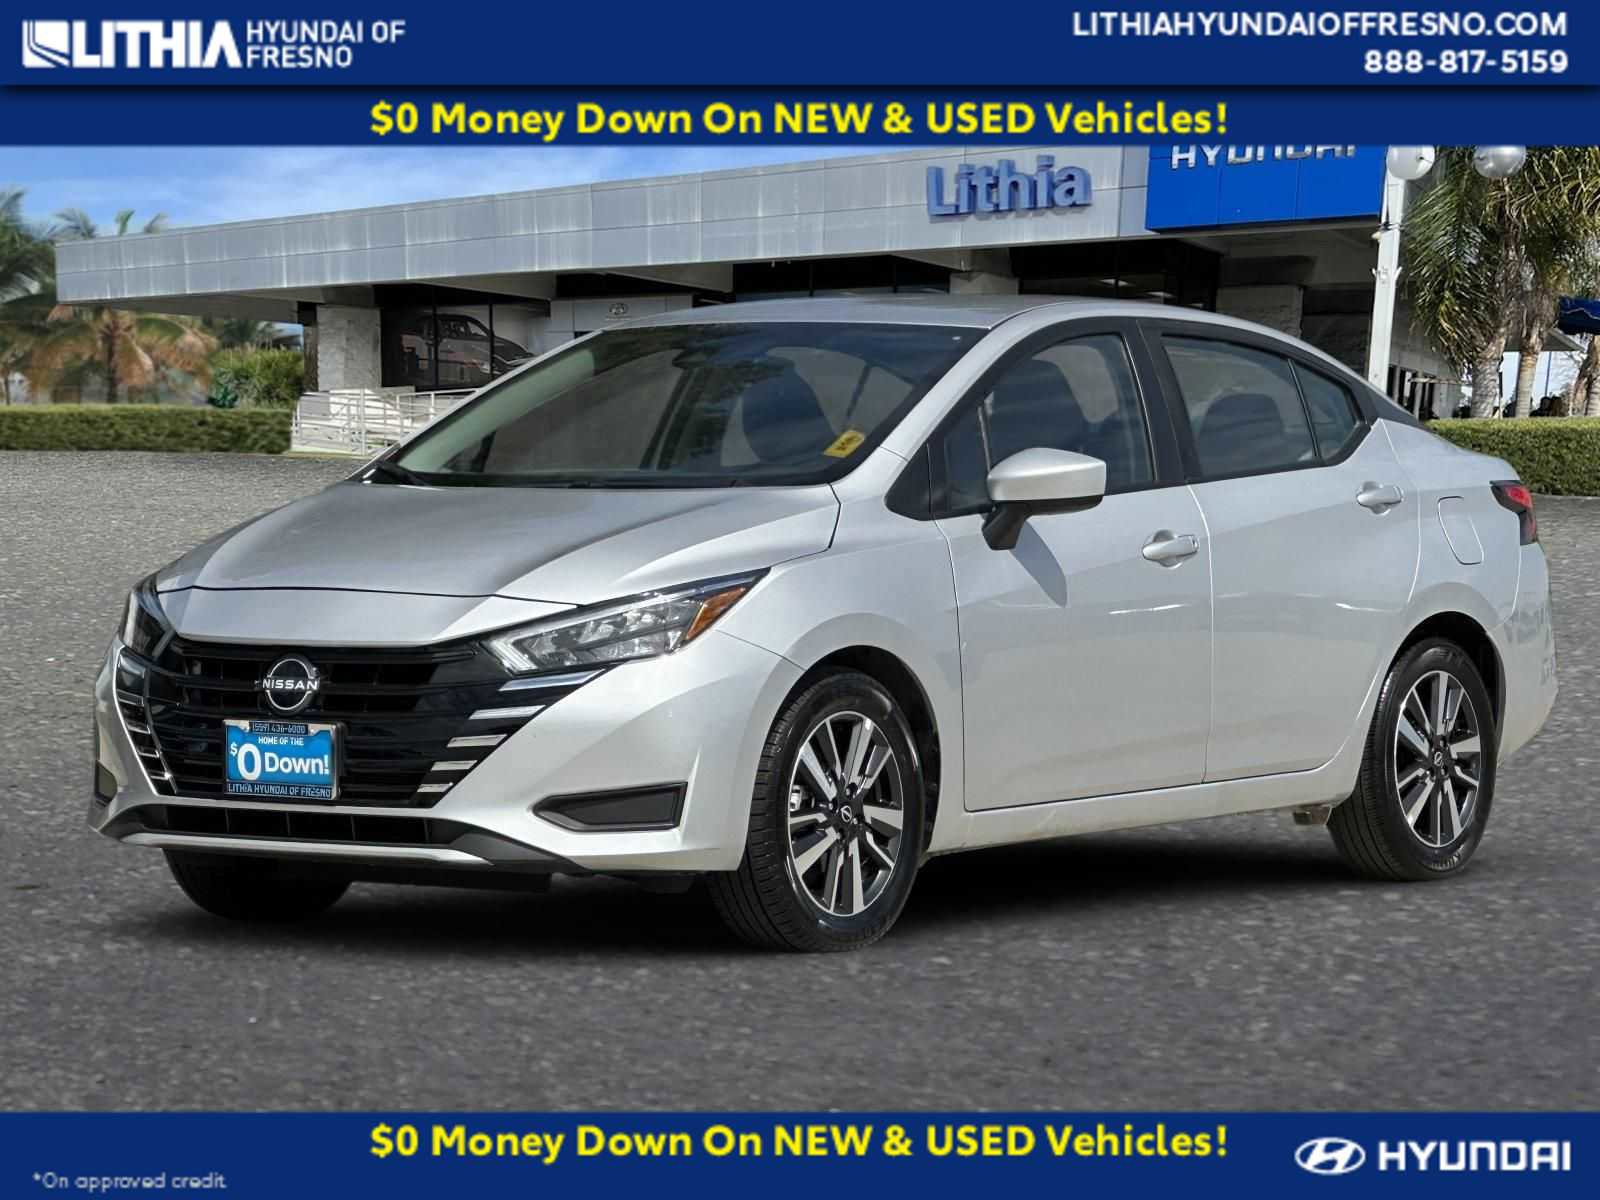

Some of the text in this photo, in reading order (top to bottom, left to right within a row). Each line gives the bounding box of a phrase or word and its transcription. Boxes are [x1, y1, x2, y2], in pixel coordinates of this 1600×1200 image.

[927, 155, 1092, 215] Lithia
[262, 678, 319, 691] NISSAN
[258, 736, 304, 746] HOME OF THE
[264, 752, 330, 775] Down!
[228, 783, 253, 793] LITHIA
[254, 785, 288, 796] HYUNDAI
[289, 786, 300, 796] OF
